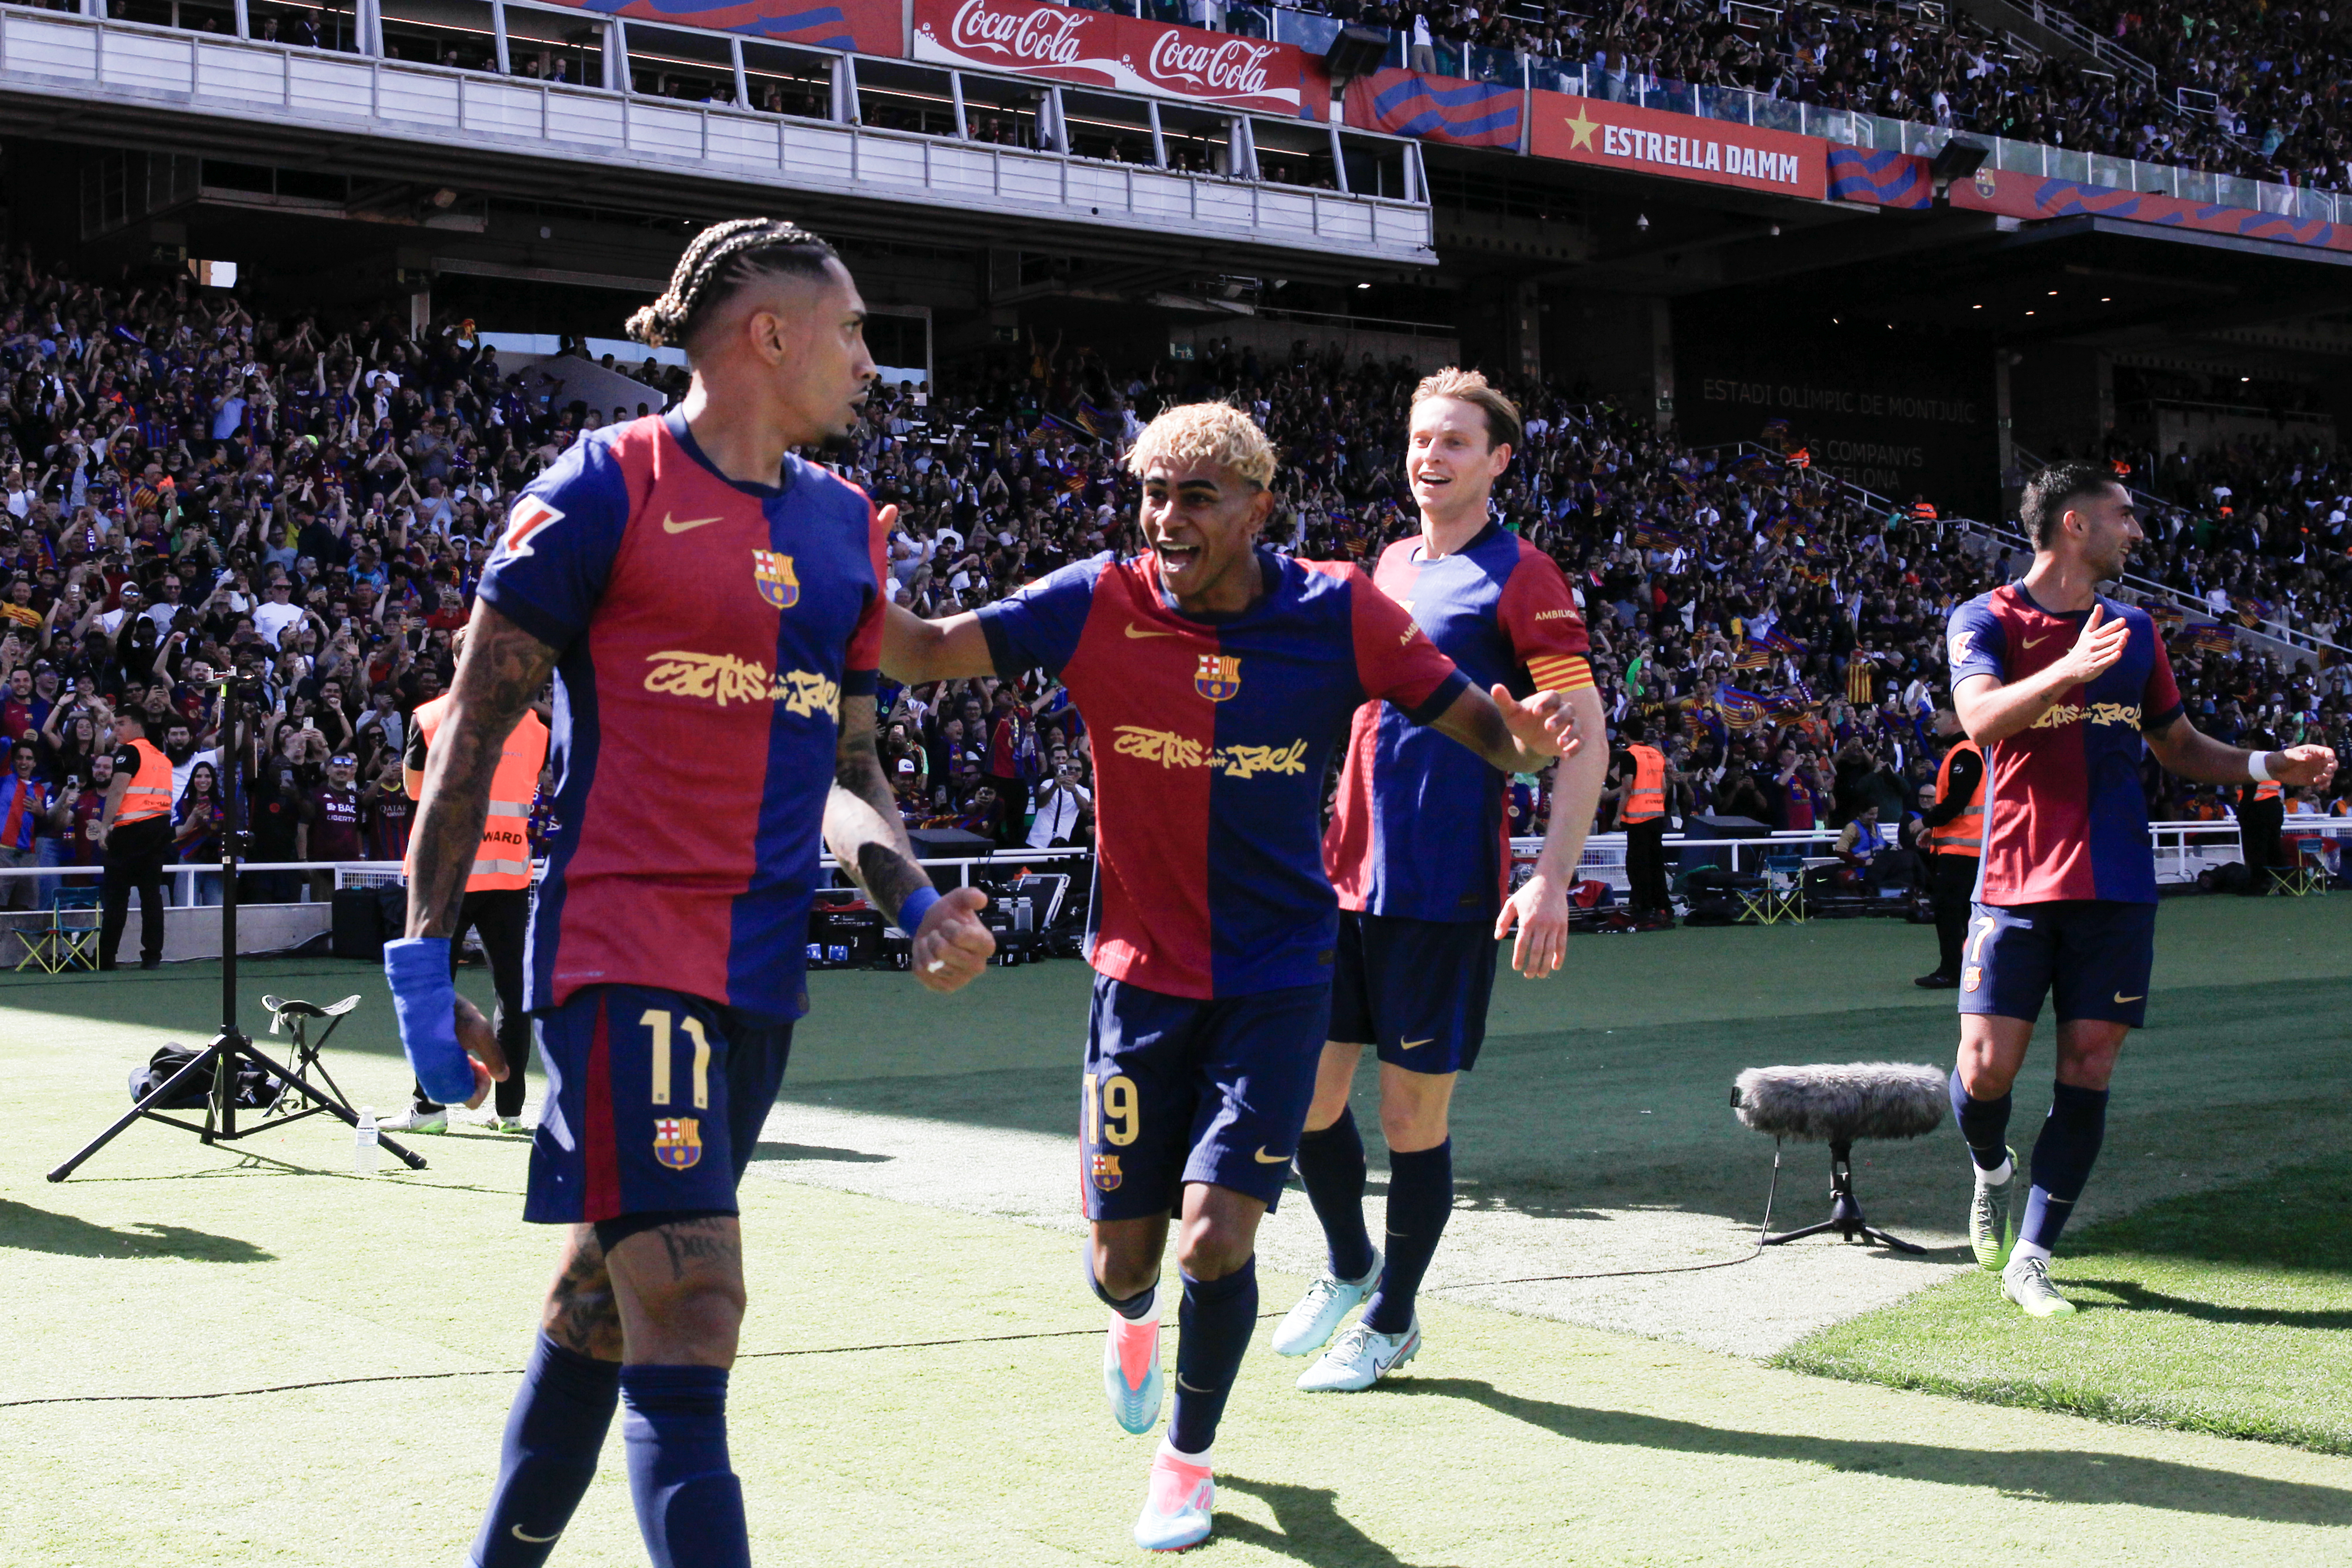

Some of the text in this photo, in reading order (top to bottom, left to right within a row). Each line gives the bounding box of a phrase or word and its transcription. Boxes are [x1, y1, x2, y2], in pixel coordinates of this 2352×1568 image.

[952, 0, 1087, 64] Coca-Cola
[1149, 30, 1274, 92] Coca-Cola
[1603, 124, 1798, 183] ESTRELLA DAMM
[1704, 378, 1771, 405] ESTADI
[1779, 384, 1853, 412] OLÍMPIC
[1860, 394, 1884, 415] DE
[1827, 439, 1923, 467] COMPANYS
[379, 805, 407, 814] QATAR
[483, 831, 522, 845] WARD
[1974, 916, 1995, 962] 7
[639, 1009, 711, 1110] 11
[1084, 1073, 1139, 1146] 19
